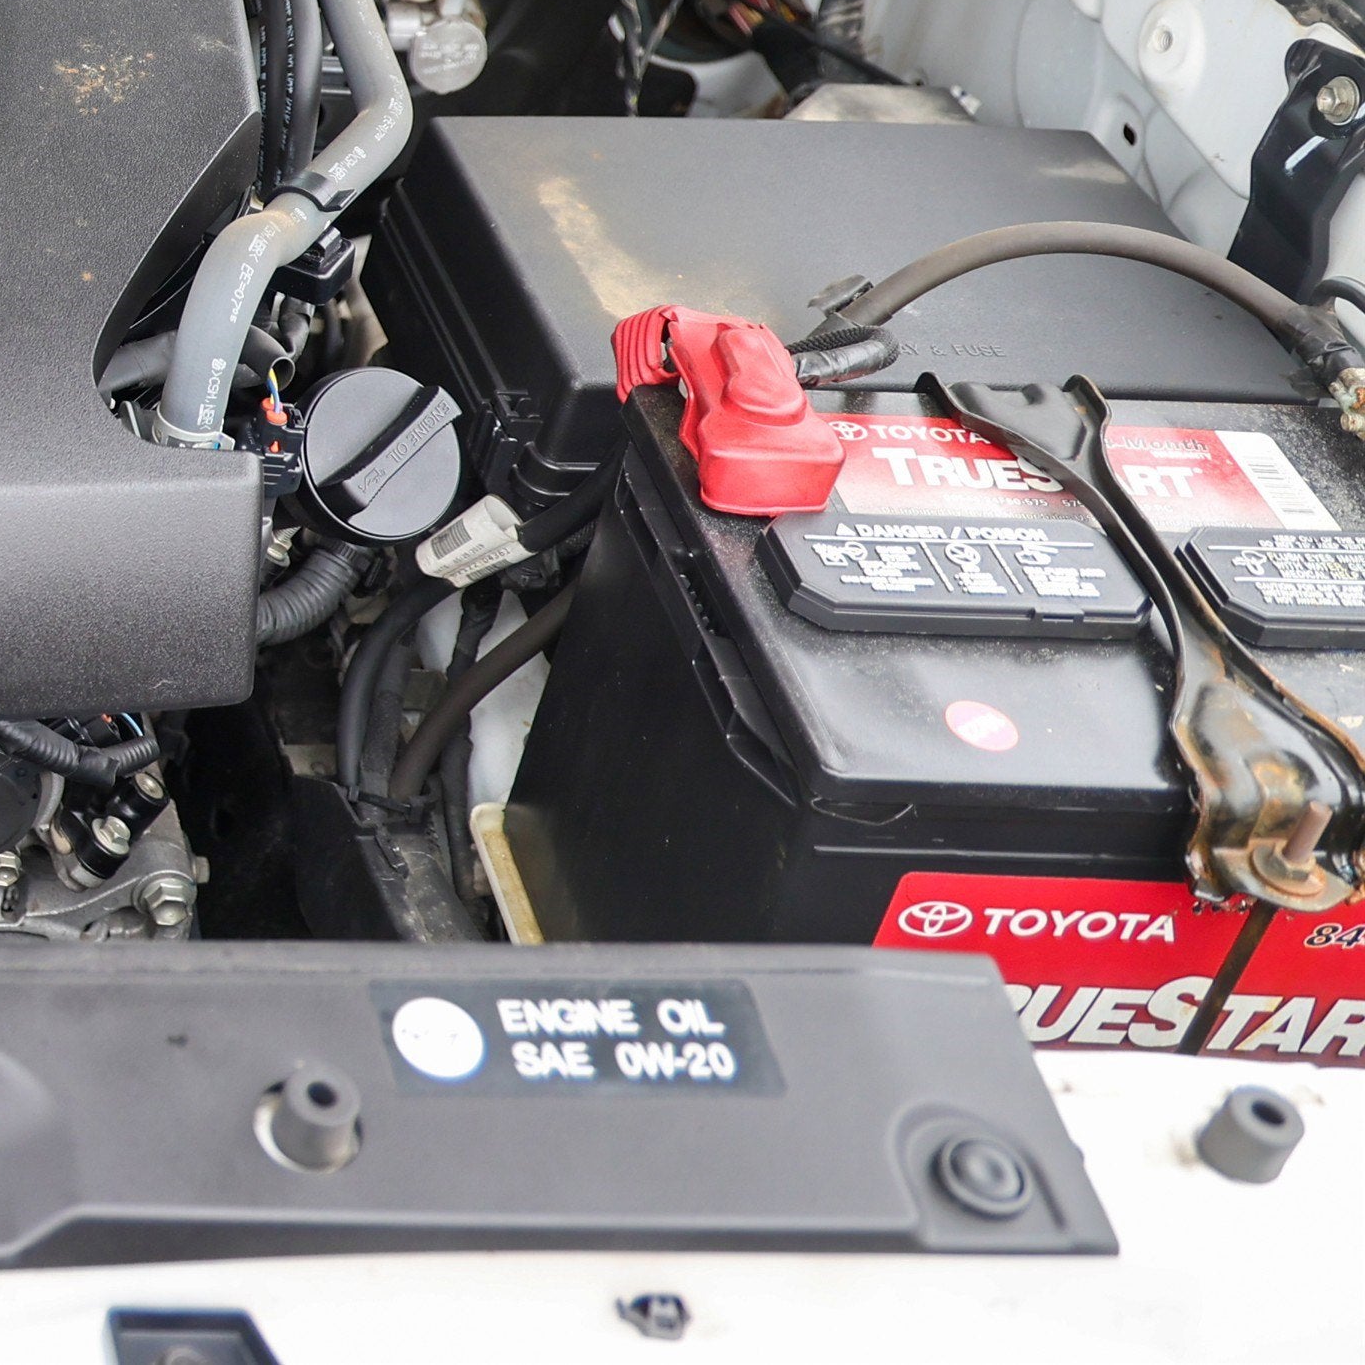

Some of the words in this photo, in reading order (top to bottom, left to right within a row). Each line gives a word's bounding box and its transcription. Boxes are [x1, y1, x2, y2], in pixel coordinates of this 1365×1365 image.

[953, 344, 1007, 357] FUSE
[406, 398, 451, 447] ENGINE
[869, 424, 991, 445] TOYOTA
[385, 441, 409, 464] OIL
[855, 523, 949, 540] DANGER
[965, 526, 1049, 542] POISON
[983, 907, 1176, 943] TOYOTA
[497, 998, 641, 1035] ENGINE
[656, 998, 725, 1035] OIL
[511, 1041, 597, 1079] SAE
[614, 1041, 738, 1080] 0W-20
